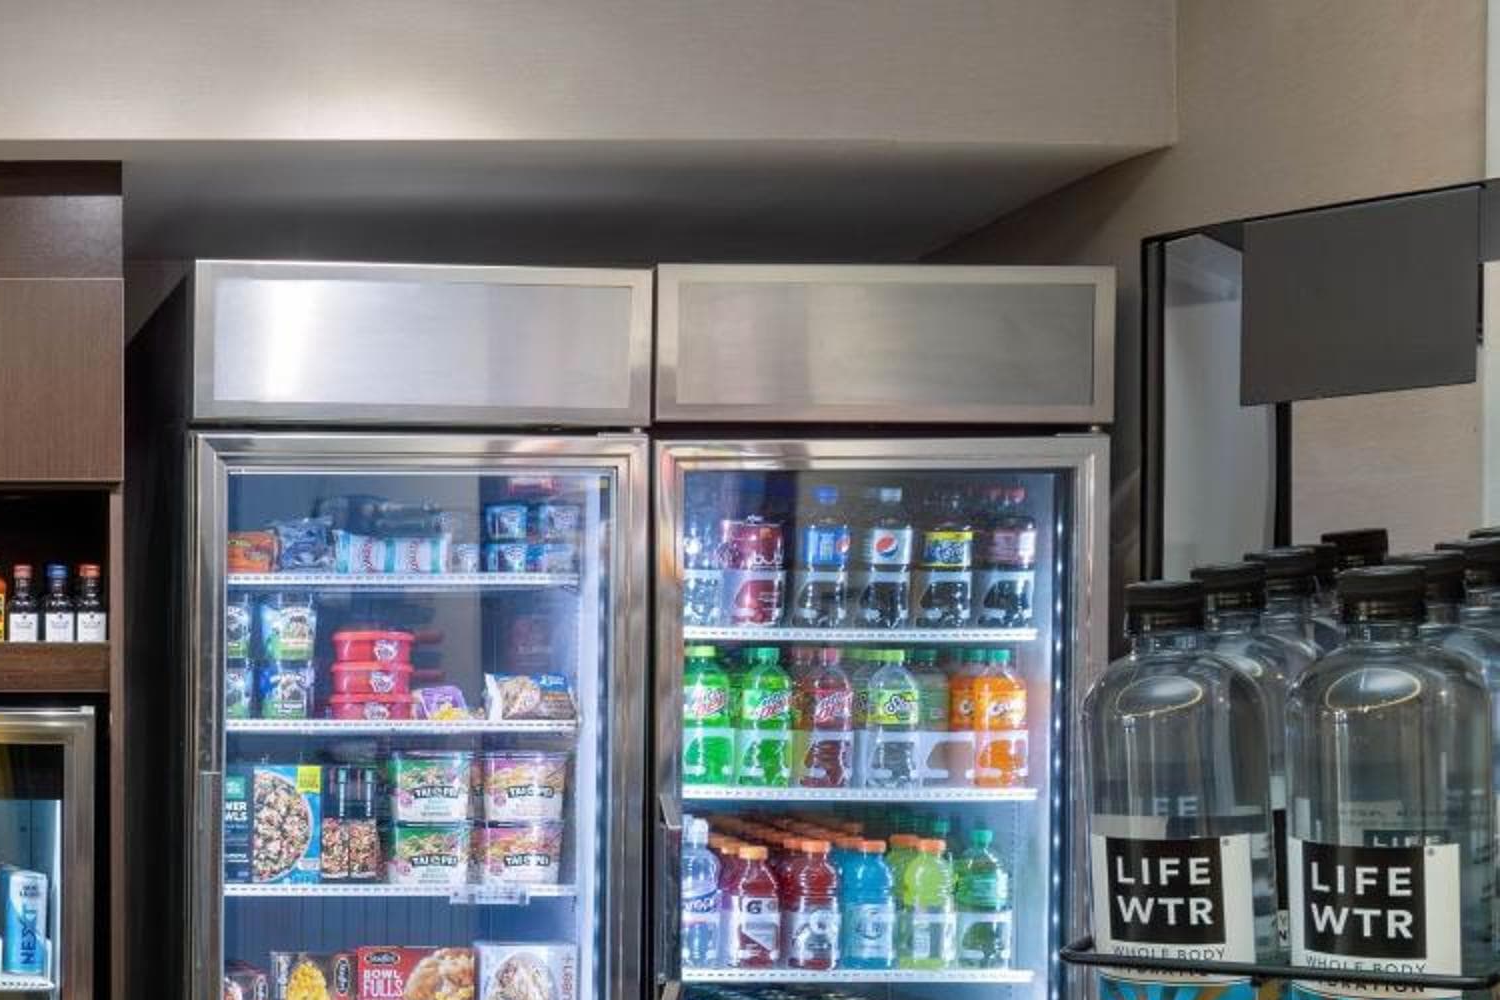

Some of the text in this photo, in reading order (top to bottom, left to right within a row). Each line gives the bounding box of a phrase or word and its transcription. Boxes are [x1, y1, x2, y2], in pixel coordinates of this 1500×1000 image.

[1116, 855, 1212, 886] LIFE
[1310, 861, 1413, 897] LIFE
[1116, 895, 1214, 926] WTR
[1310, 903, 1414, 939] WTR
[364, 979, 403, 997] FULLS
